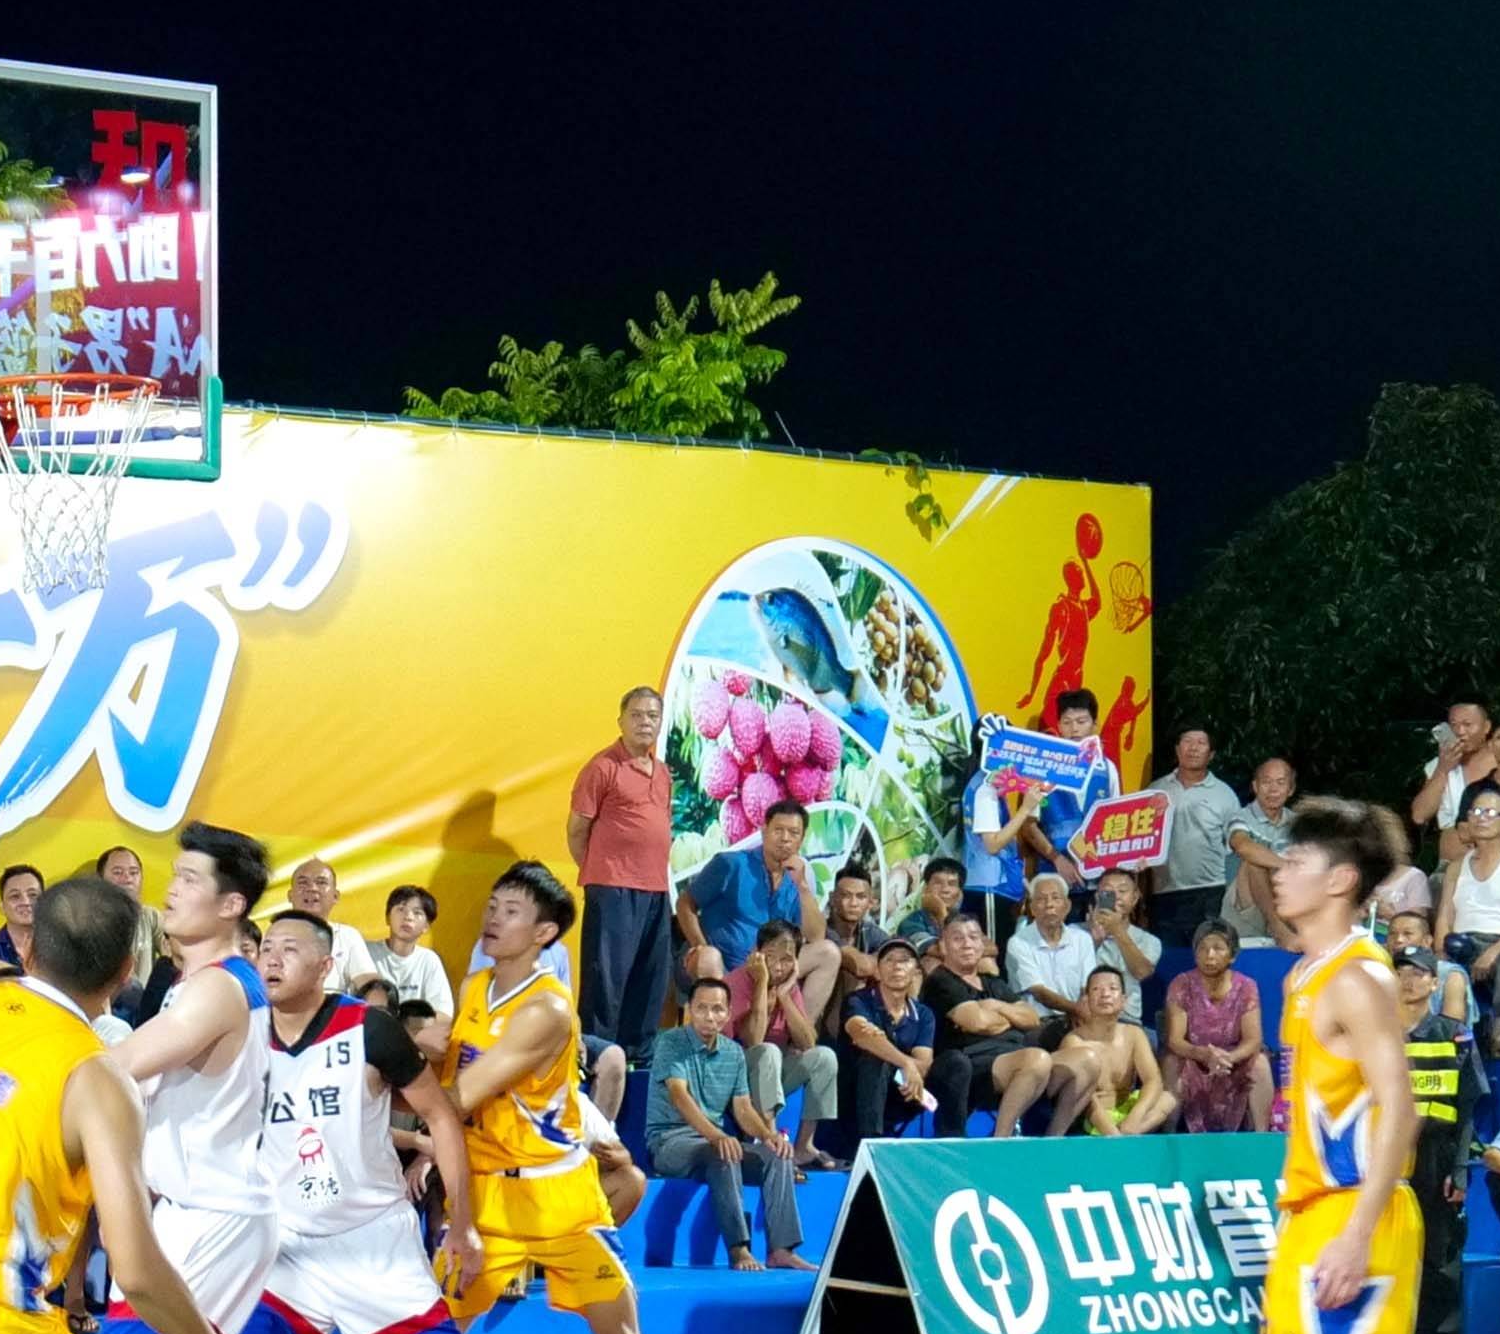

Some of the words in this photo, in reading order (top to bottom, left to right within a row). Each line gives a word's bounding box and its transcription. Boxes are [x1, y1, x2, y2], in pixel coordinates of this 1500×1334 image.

[325, 1041, 351, 1068] 15
[269, 1085, 341, 1124] 公馆
[1045, 1179, 1287, 1287] 中财管
[1079, 1286, 1266, 1334] ZHONGCA
